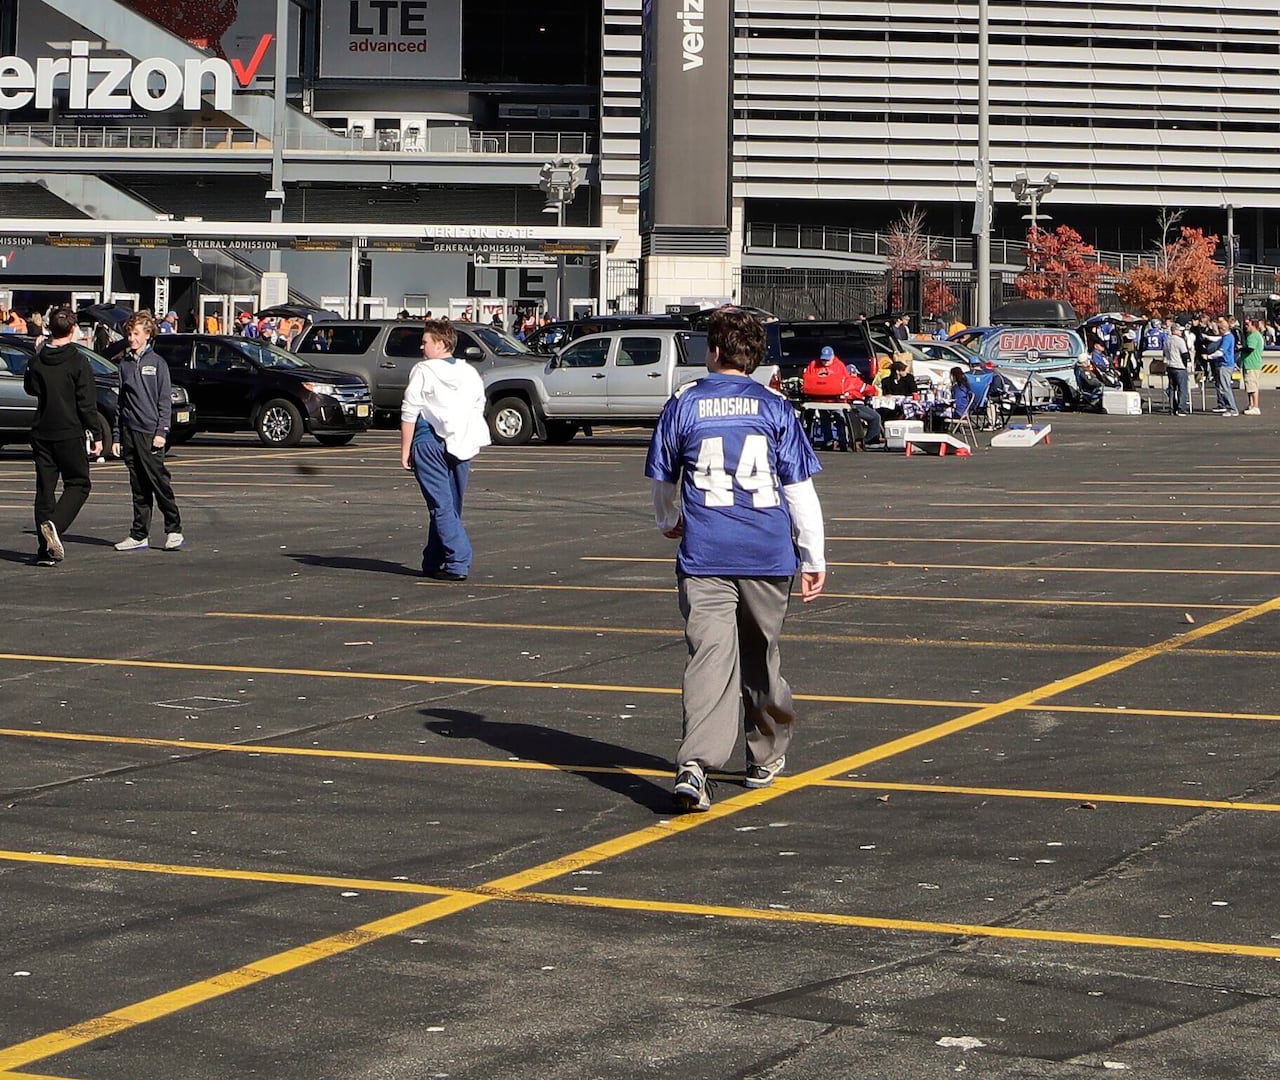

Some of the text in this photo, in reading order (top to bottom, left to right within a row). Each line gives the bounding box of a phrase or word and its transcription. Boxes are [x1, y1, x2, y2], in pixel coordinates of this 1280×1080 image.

[350, 0, 427, 35] LTE
[349, 39, 426, 52] advanced
[424, 227, 535, 238] VERIZON GATE
[187, 240, 277, 249] GENERAL ADMISSION
[434, 244, 526, 252] GENERAL ADMISSION
[467, 262, 546, 297] LTE
[1000, 334, 1070, 350] GIANTS
[699, 398, 758, 418] BRADSHAW
[693, 434, 780, 508] 44
